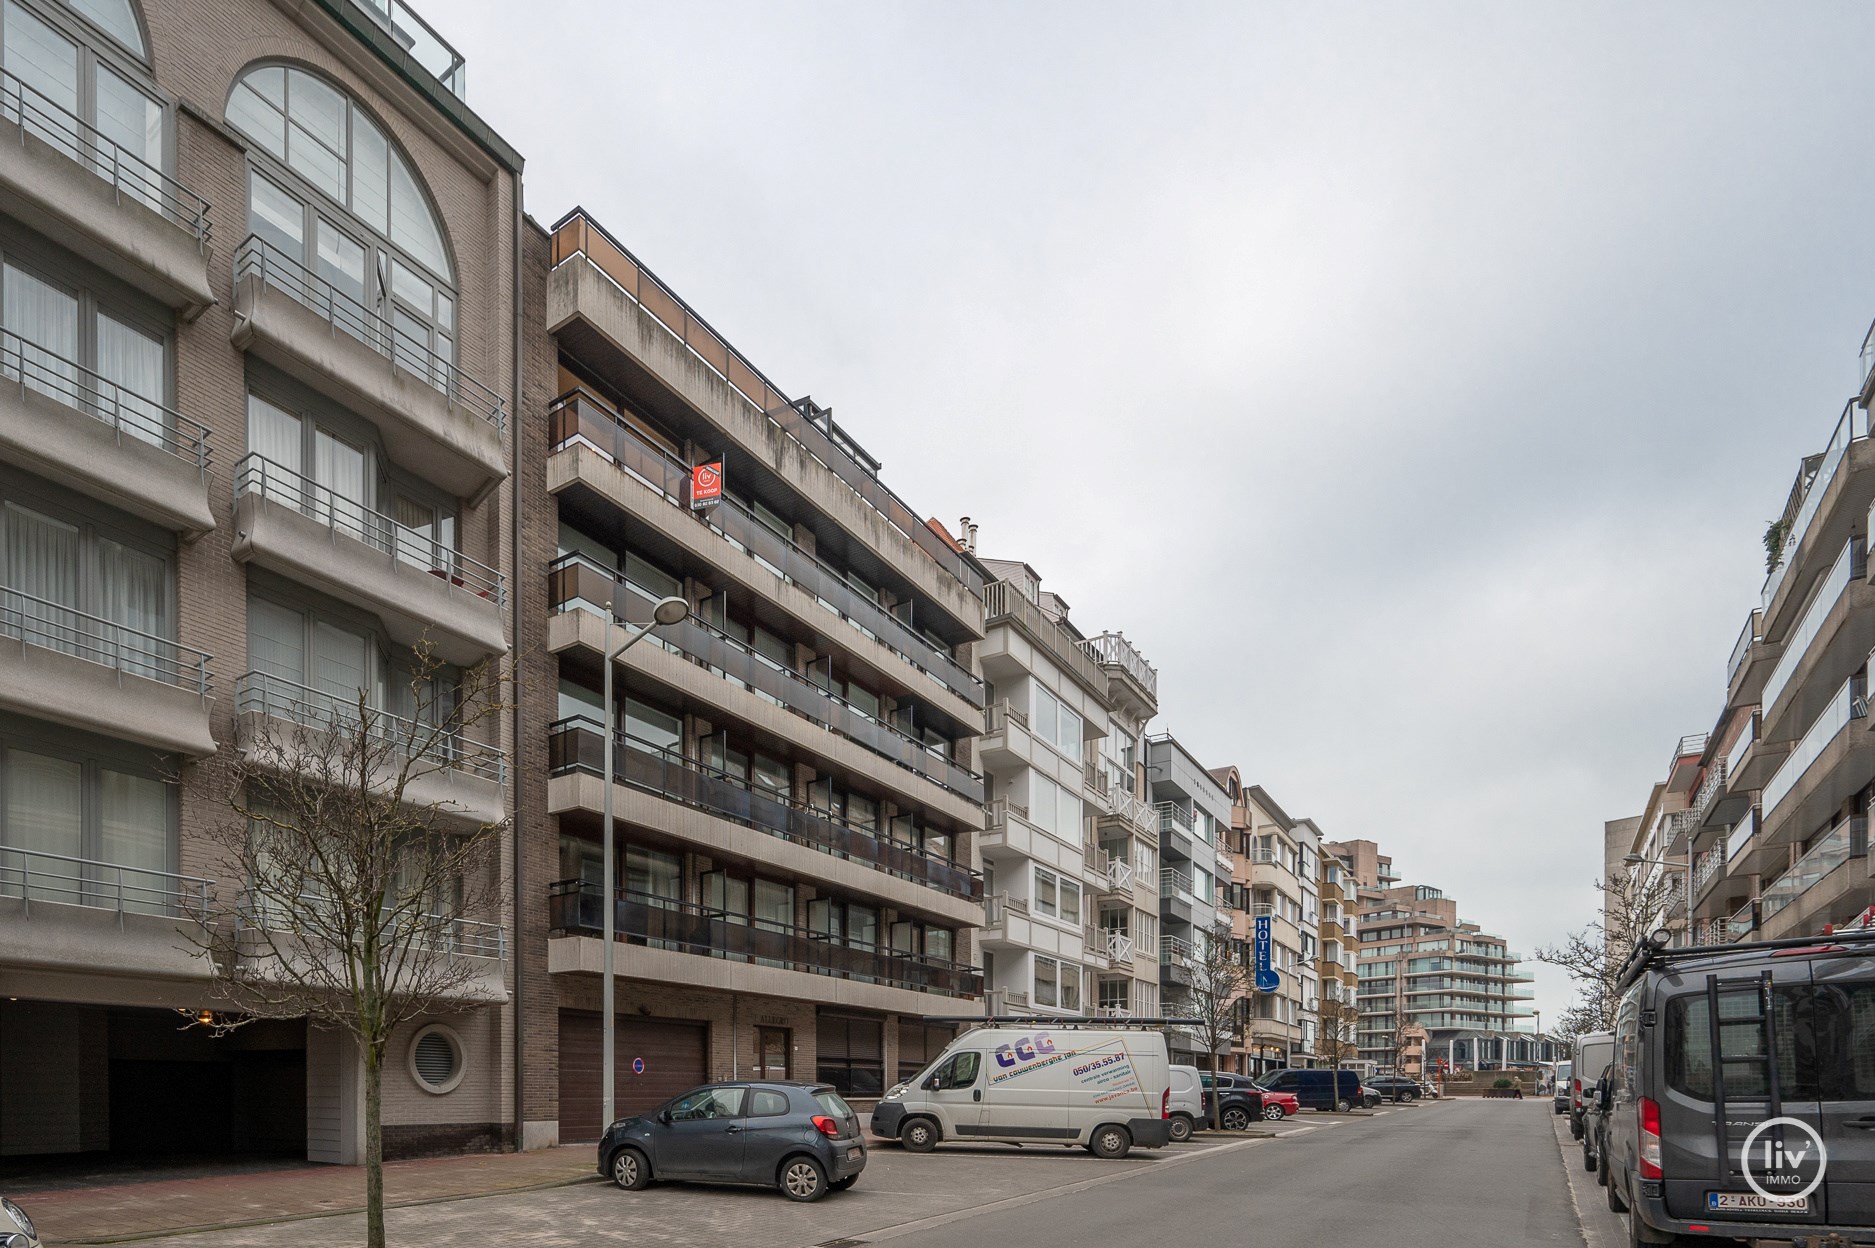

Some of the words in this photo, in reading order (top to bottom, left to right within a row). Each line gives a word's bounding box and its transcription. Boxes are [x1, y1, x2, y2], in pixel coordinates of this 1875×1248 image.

[1258, 920, 1268, 972] HOTEL
[992, 1073, 1008, 1083] van
[1063, 1050, 1077, 1061] jan
[1073, 1052, 1125, 1077] 050/35.55.87
[1081, 1073, 1101, 1084] centrale
[1101, 1064, 1130, 1077] verwarming
